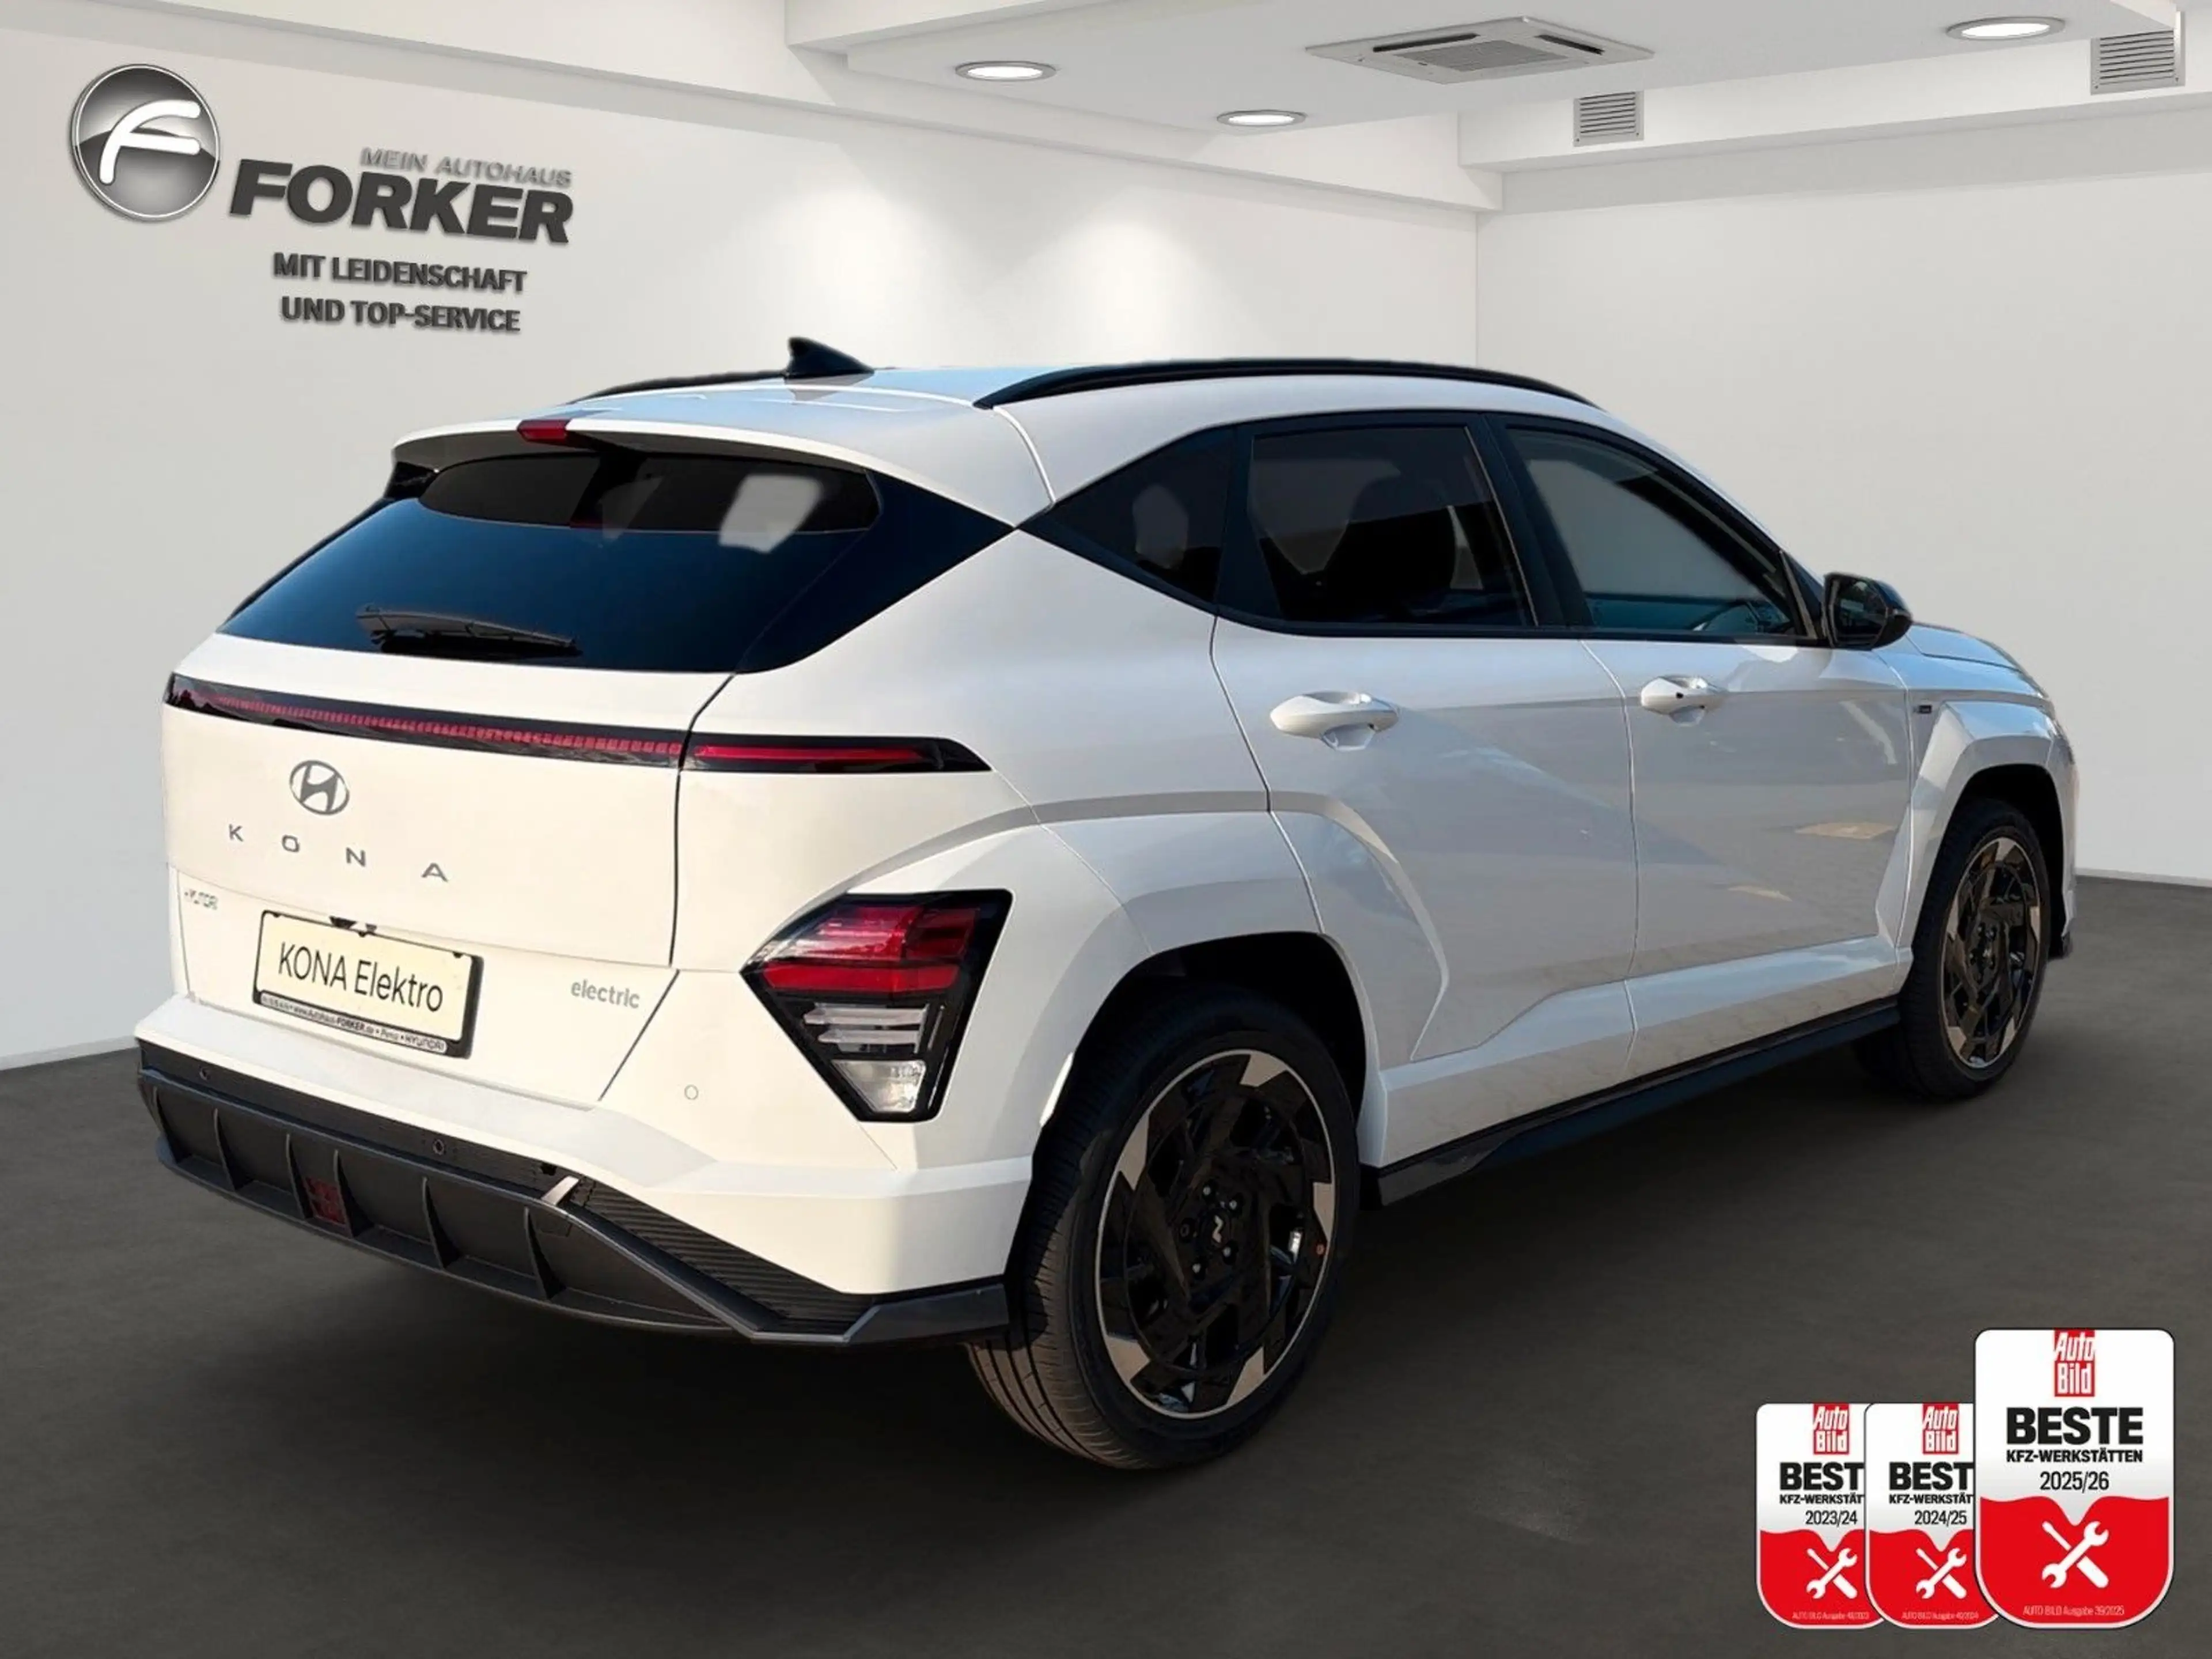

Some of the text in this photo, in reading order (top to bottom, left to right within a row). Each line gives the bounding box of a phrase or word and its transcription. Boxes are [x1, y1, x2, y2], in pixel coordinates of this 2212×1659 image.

[361, 147, 572, 188] MEIN AUTOHAUS
[230, 158, 574, 244] FORKER
[273, 252, 528, 292] MIT LEIDENSCHAFT
[281, 296, 521, 332] UND TOP-SERVICE
[228, 823, 449, 882] KONA
[278, 941, 444, 1012] KONA Elektro
[571, 979, 640, 1009] electric
